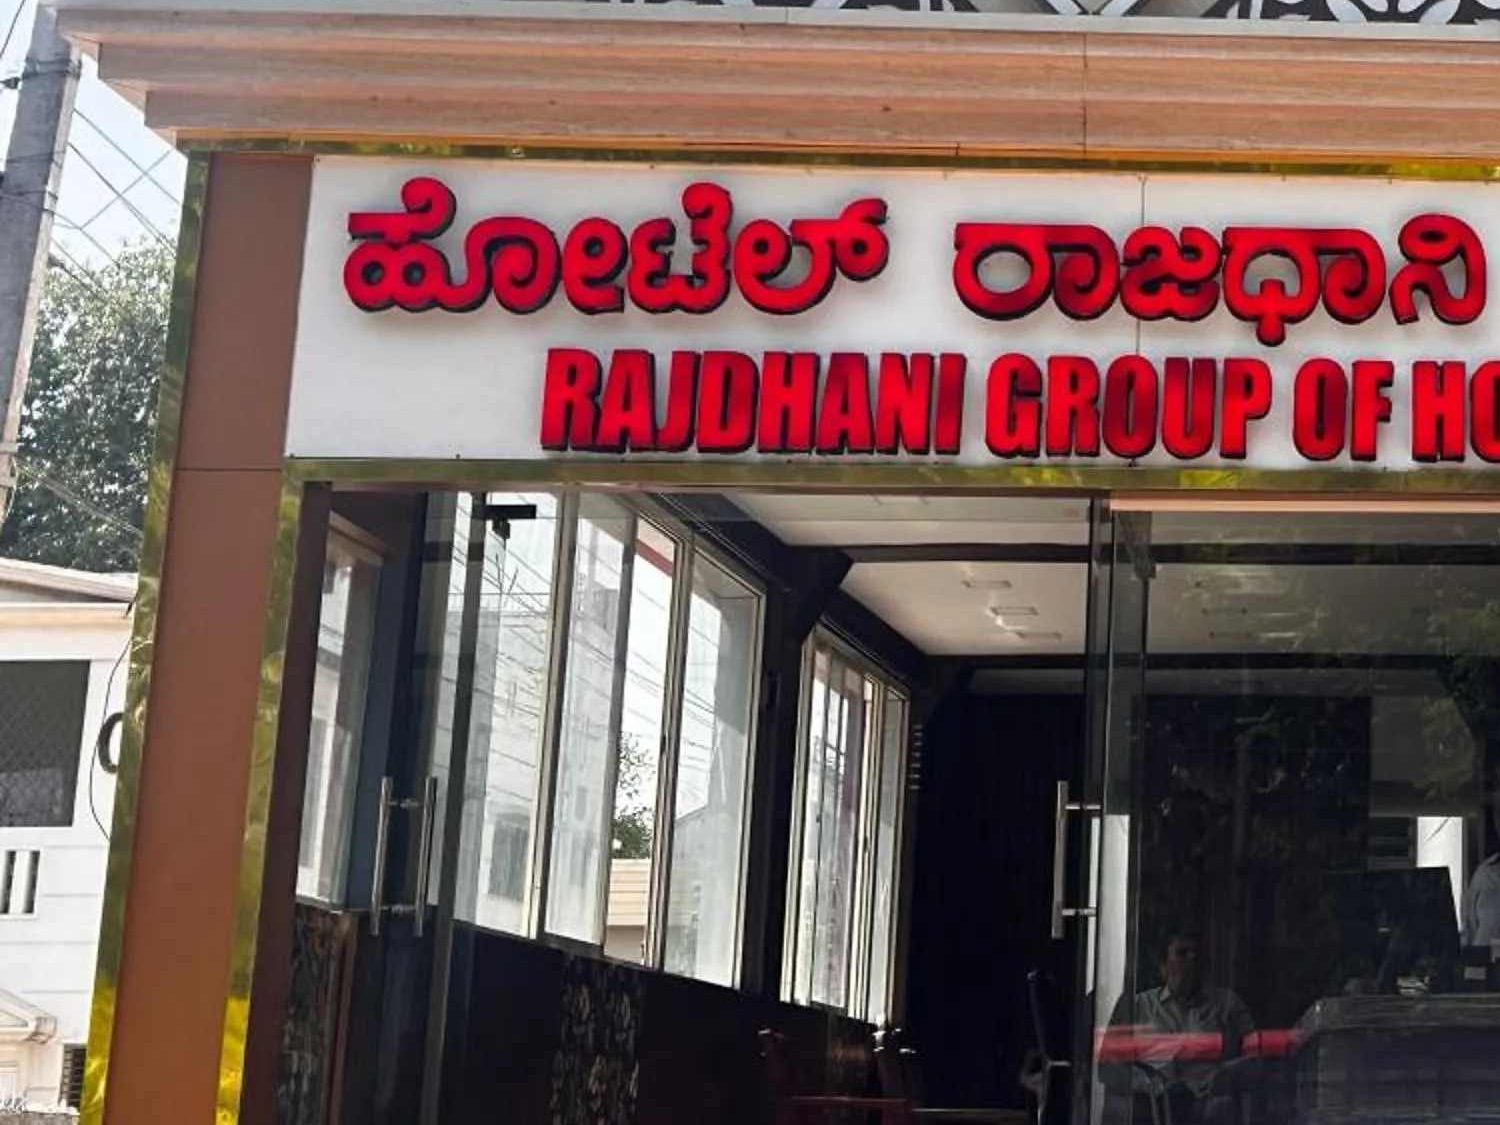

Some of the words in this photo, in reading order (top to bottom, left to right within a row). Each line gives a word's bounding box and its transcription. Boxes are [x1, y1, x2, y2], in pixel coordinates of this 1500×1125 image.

[344, 177, 889, 314] ಹೋಟೆಲ್
[953, 213, 1487, 346] ರಾಜಧಾನಿ
[540, 347, 967, 455] RAJDHANI
[985, 352, 1272, 459] GROUP
[1293, 357, 1395, 461] OF
